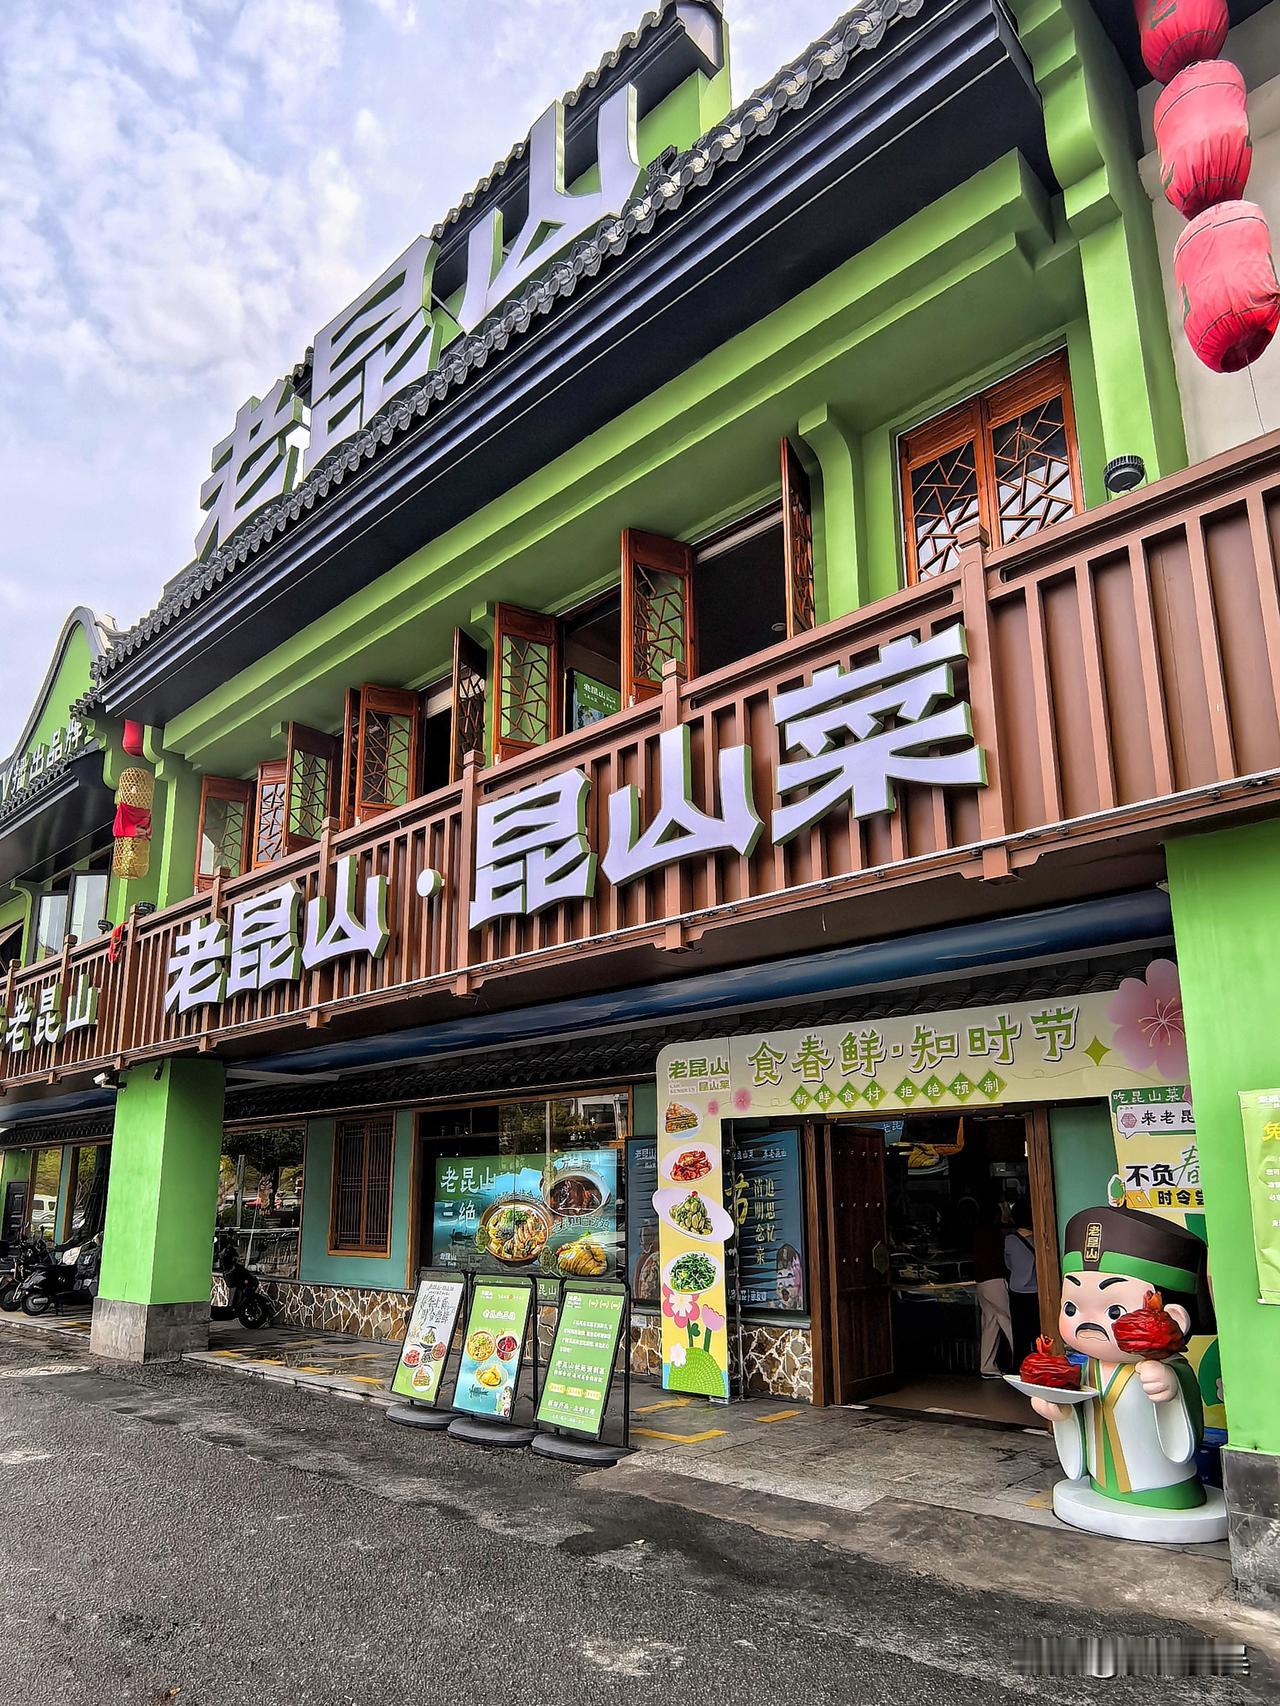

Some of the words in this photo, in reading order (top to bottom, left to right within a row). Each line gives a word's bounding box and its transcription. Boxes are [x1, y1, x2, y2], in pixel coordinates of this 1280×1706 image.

[194, 82, 648, 562] 老昆山
[5, 974, 98, 1053] 老昆山
[747, 1004, 1079, 1088] 食春鲜·知时节
[668, 1056, 730, 1079] 老昆山
[794, 1083, 881, 1106] 新鲜食材
[899, 1077, 1000, 1097] 拒绝预制
[1112, 1086, 1181, 1104] 吃昆山菜
[440, 1166, 496, 1194] 老昆山
[1086, 1225, 1100, 1259] 老昆山
